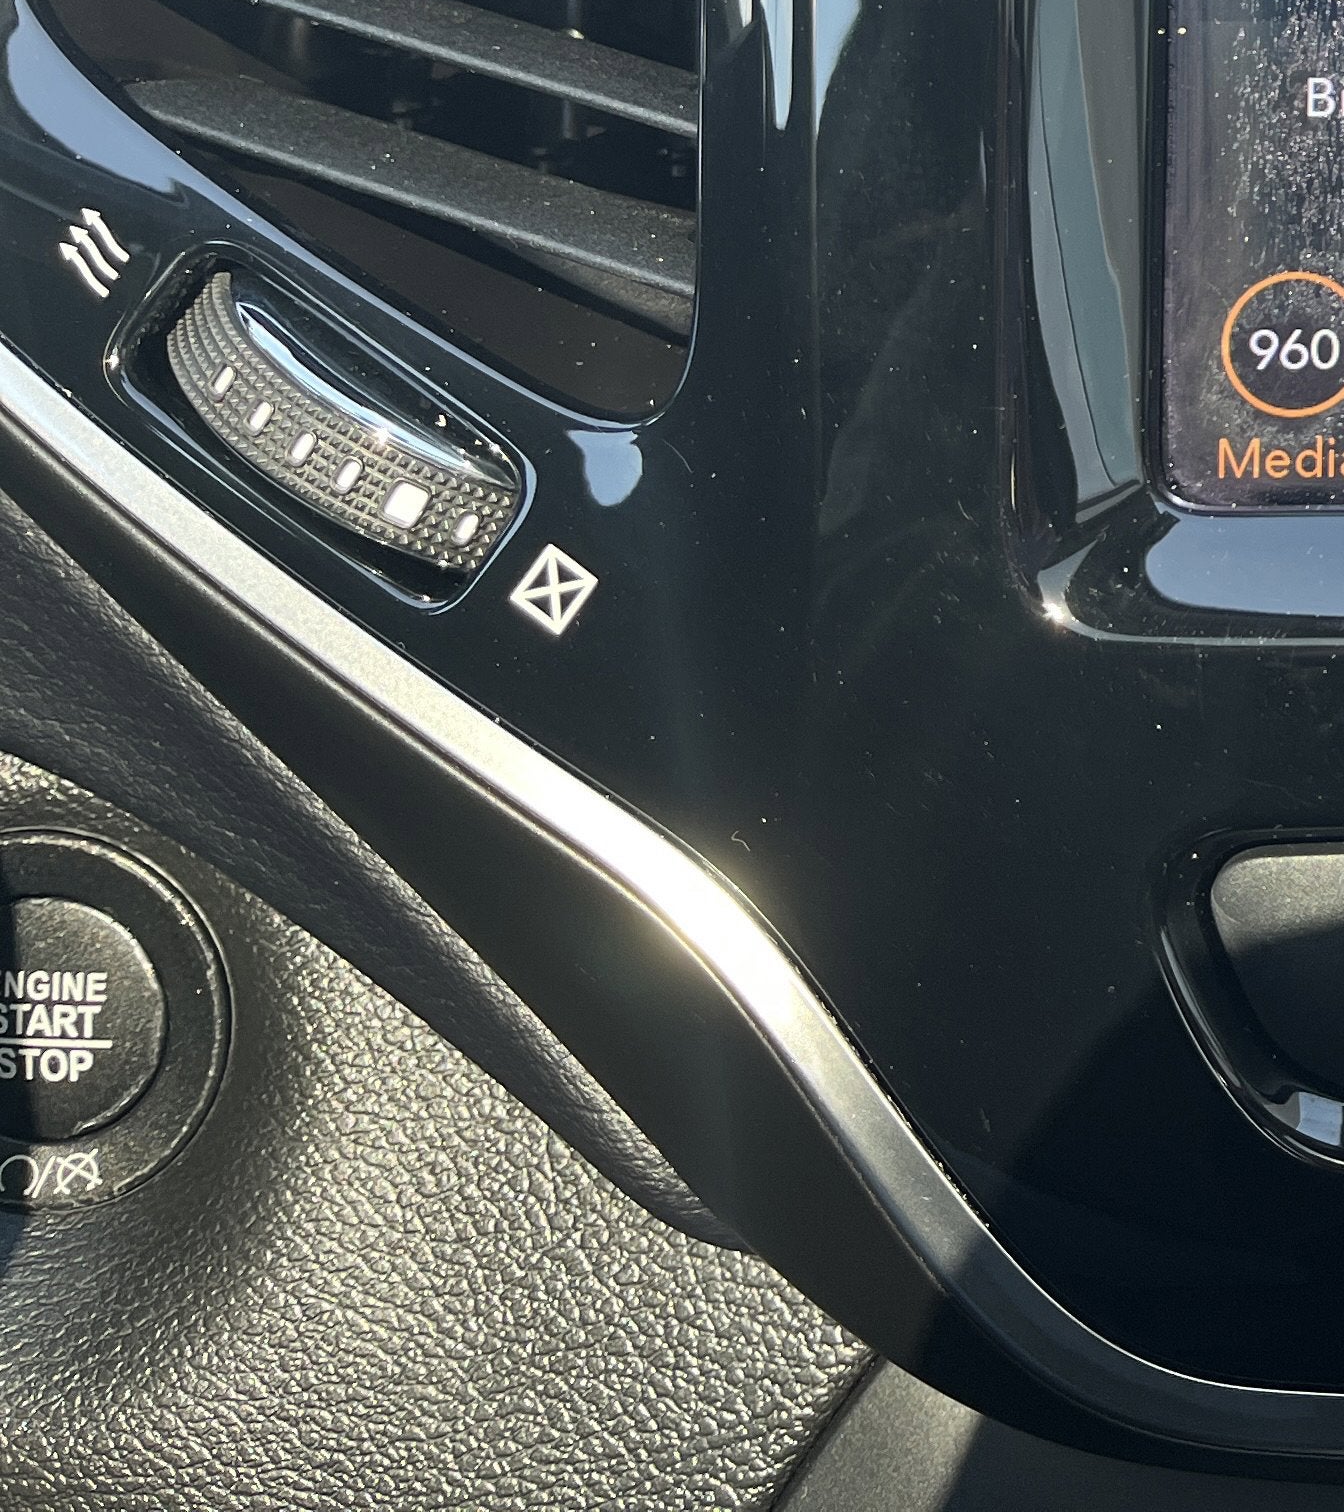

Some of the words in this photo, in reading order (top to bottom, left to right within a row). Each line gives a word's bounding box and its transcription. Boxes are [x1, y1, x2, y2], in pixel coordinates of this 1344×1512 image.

[1247, 328, 1340, 372] 960
[0, 970, 108, 1002] NGINE
[0, 1048, 94, 1082] STOP
